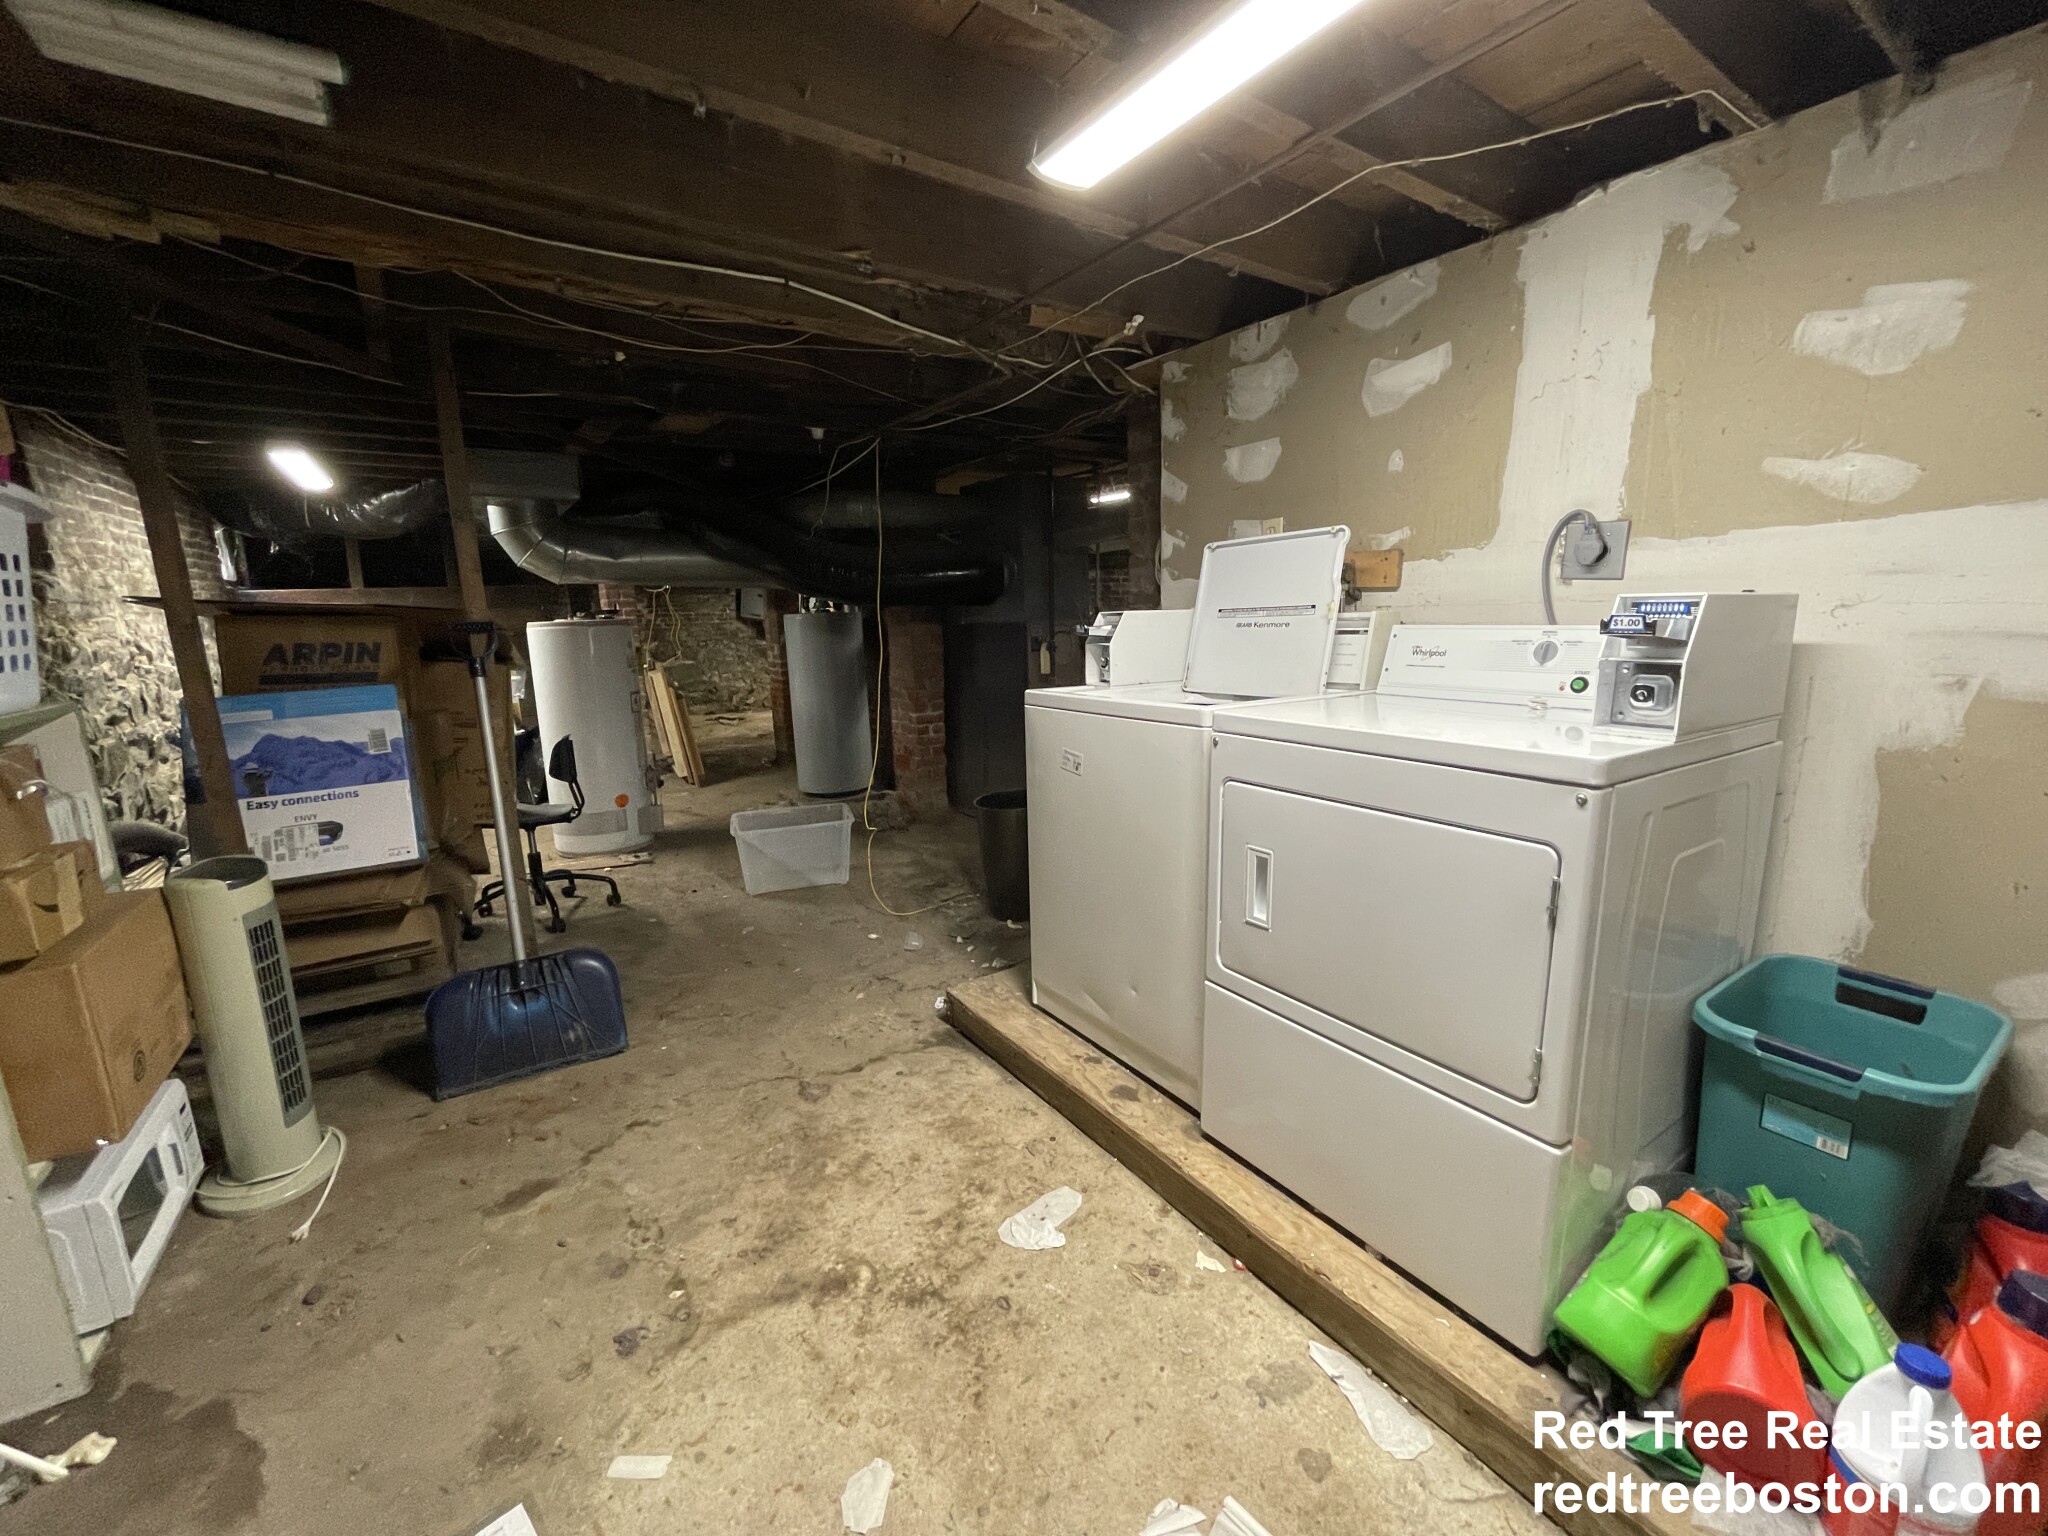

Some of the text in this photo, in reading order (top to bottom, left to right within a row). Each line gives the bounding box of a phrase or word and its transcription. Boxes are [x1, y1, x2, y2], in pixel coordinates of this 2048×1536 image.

[1253, 621, 1290, 629] Kenmore
[1612, 617, 1641, 628] $1.00
[262, 640, 382, 667] ARPIN
[1412, 648, 1448, 659] Whirlpool
[246, 789, 360, 811] Easy connections
[294, 813, 318, 823] ENVY
